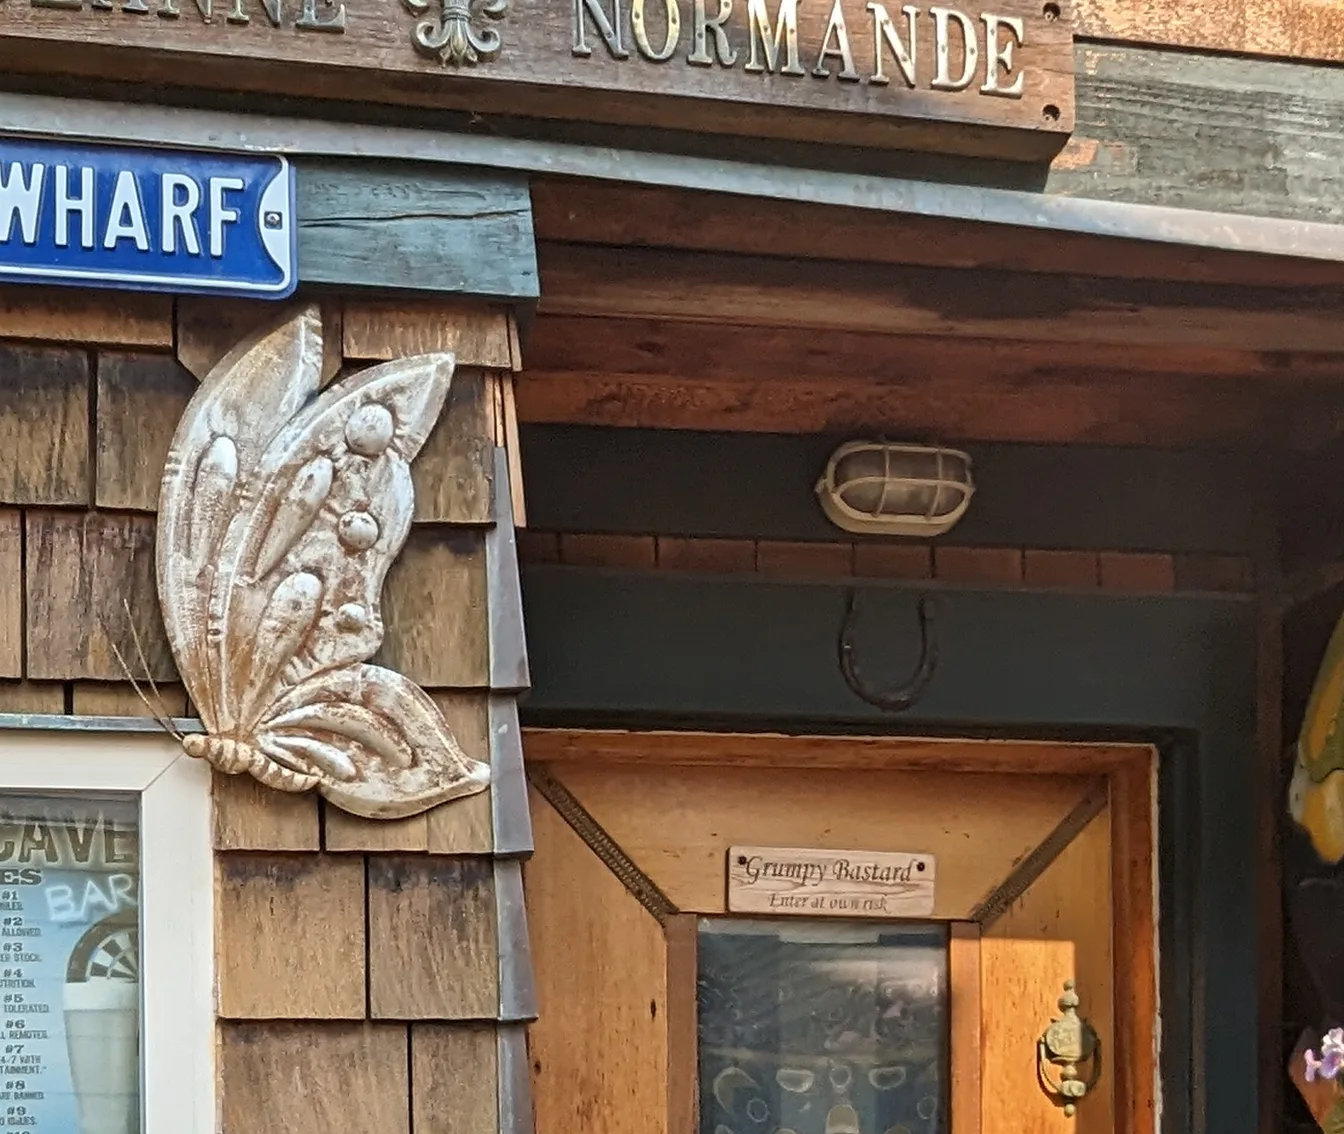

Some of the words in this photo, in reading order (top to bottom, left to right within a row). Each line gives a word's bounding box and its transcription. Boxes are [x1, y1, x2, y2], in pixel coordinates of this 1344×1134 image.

[571, 0, 1025, 98] NORMANDE
[746, 856, 827, 887] Grumpy
[833, 858, 918, 883] Bastard
[2, 890, 19, 900] #1
[46, 873, 138, 922] BAR
[768, 892, 809, 909] Enter
[811, 895, 825, 909] at
[830, 897, 857, 909] own
[3, 917, 23, 926] #2
[3, 942, 23, 952] #3
[4, 969, 23, 978] #4
[4, 994, 24, 1003] #5
[6, 1020, 26, 1029] #6
[6, 1045, 24, 1054] #7
[6, 1080, 26, 1090] #8
[7, 1106, 26, 1116] #9
